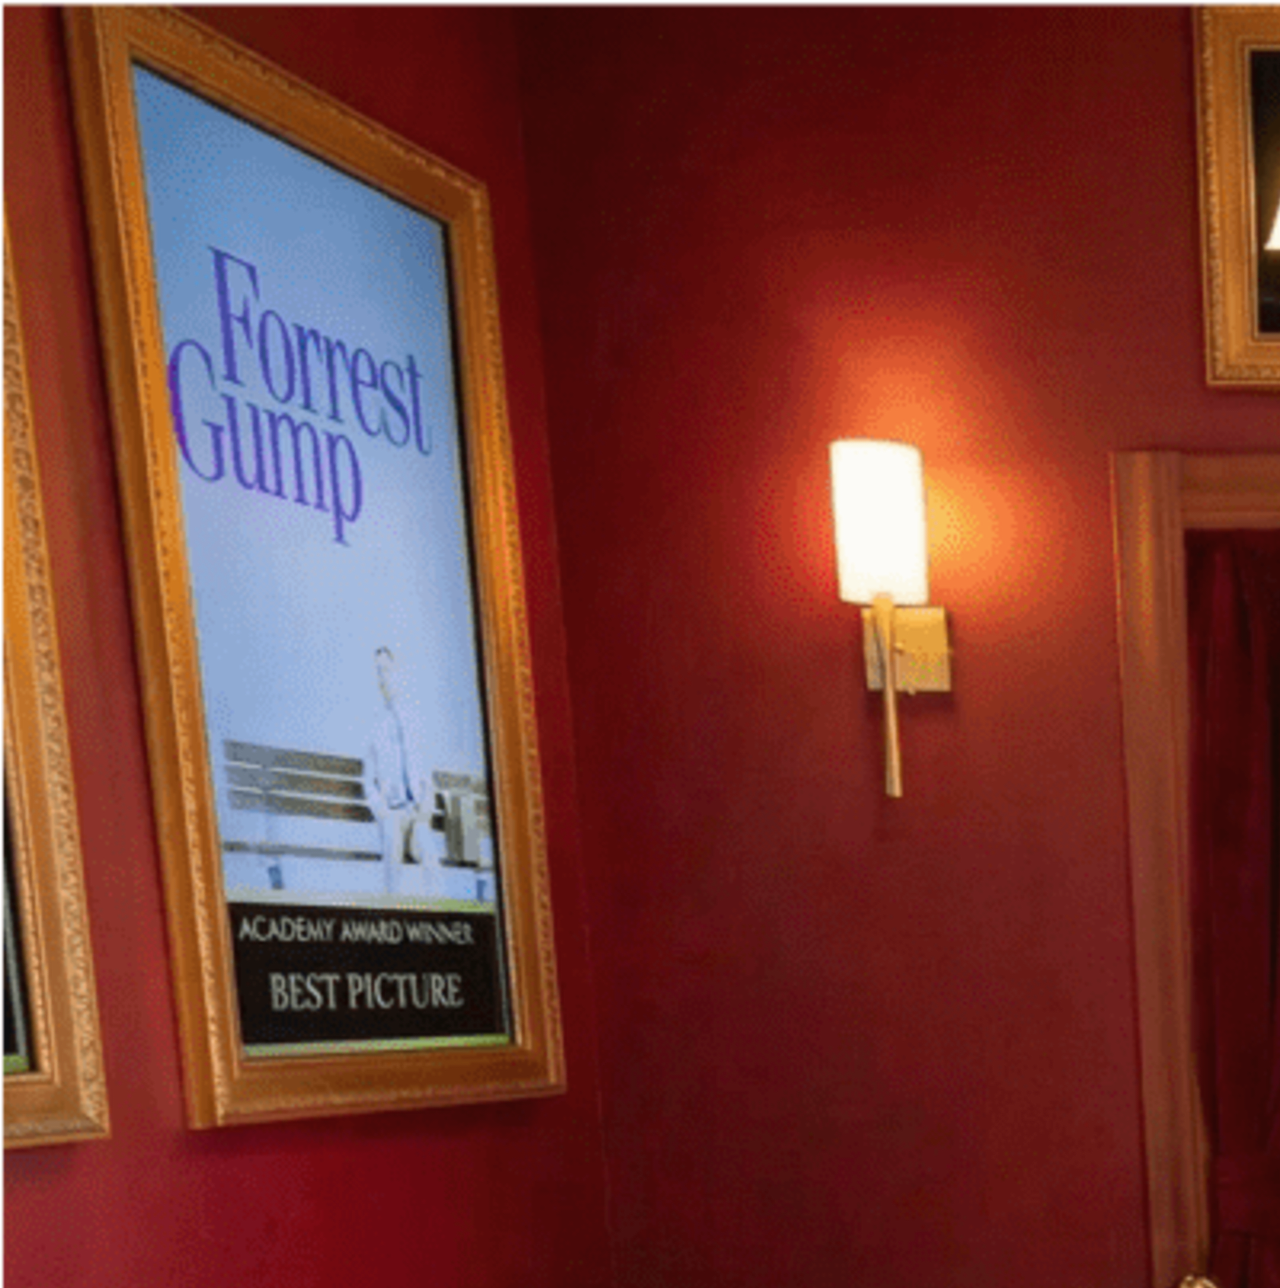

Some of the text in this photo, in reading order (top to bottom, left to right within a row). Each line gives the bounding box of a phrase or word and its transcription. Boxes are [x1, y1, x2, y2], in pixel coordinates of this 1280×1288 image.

[208, 245, 434, 456] Forrest
[167, 338, 364, 548] Gump
[238, 914, 475, 946] ACADEMY AWARD WINNER
[268, 971, 465, 1012] BEST PICTURE
